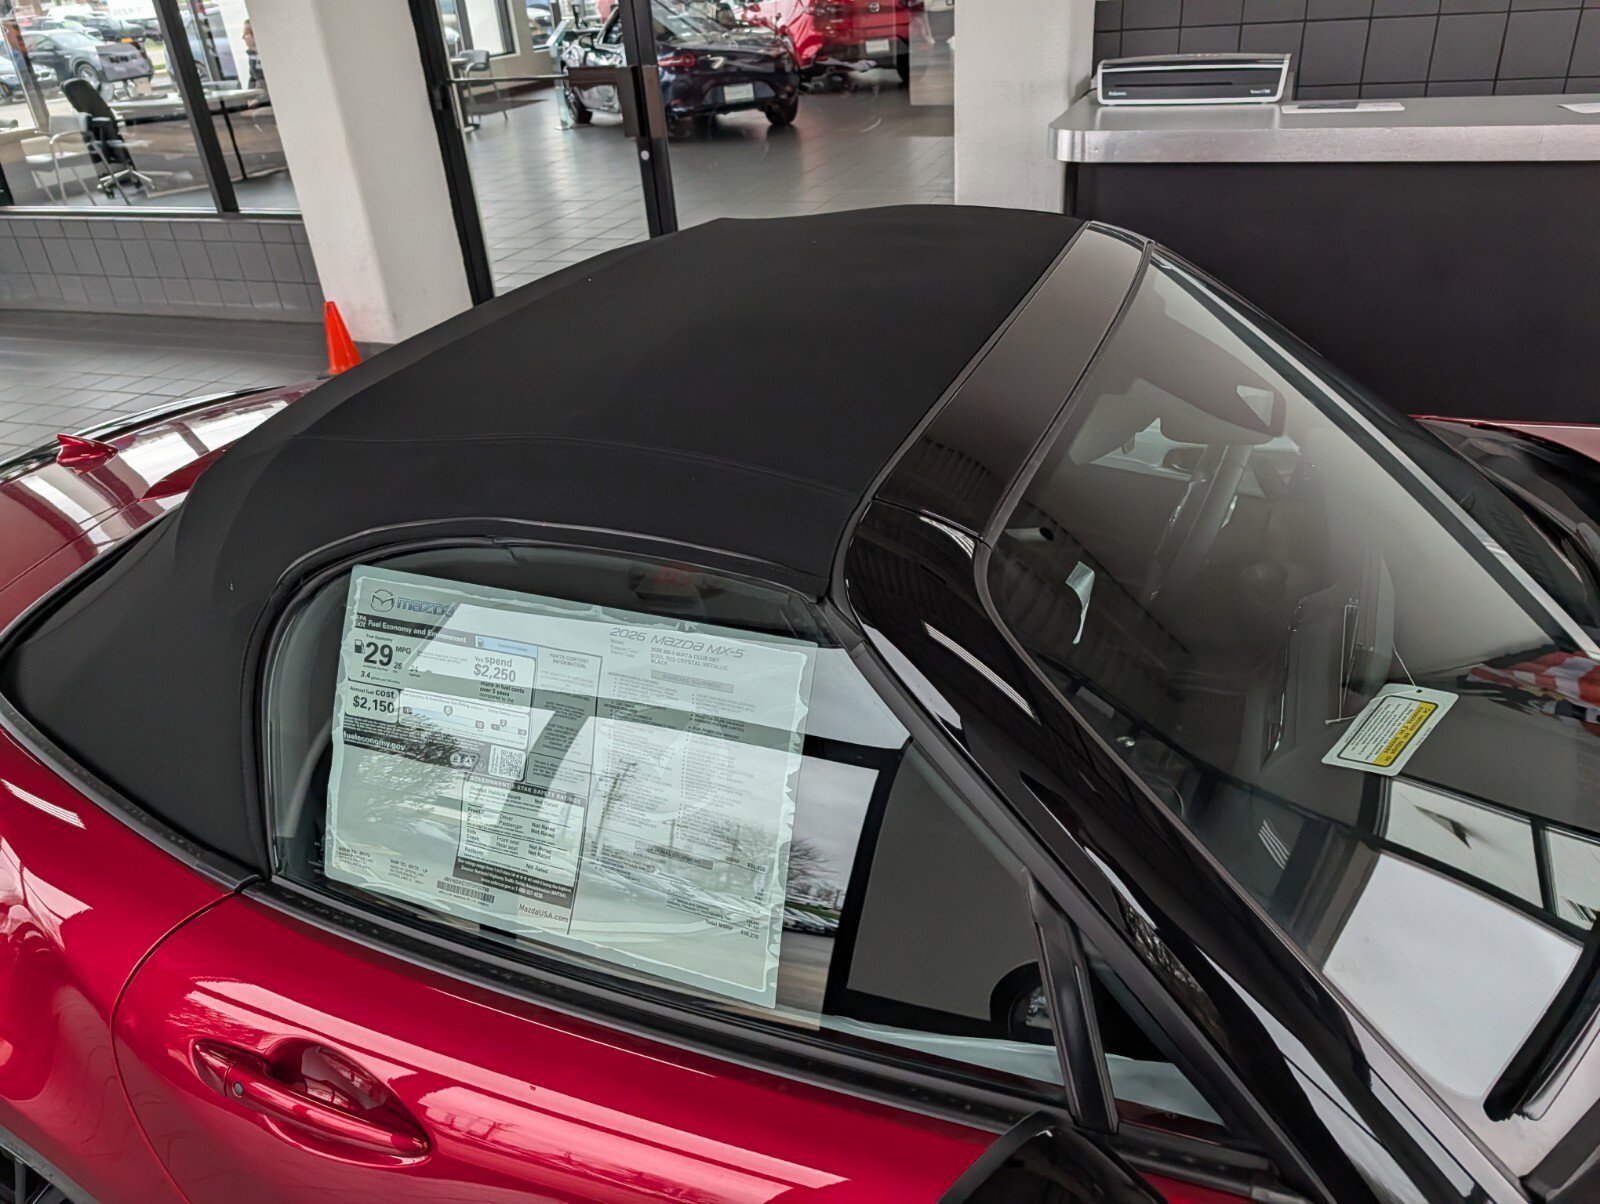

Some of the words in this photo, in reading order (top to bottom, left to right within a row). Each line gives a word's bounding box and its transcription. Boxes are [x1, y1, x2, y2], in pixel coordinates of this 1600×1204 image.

[368, 619, 381, 627] Fuel
[382, 622, 412, 634] Economy
[609, 626, 646, 642] 2026
[706, 643, 745, 658] MX-5
[363, 640, 393, 667] 29
[395, 645, 411, 654] MPG
[393, 661, 402, 669] 26
[484, 654, 512, 669] spend
[360, 670, 370, 678] 3.4
[473, 662, 516, 684] $2,250
[349, 685, 365, 693] Annual
[375, 688, 394, 698] cost
[352, 694, 395, 716] $2,150
[343, 730, 406, 752] fueleconomy.gov
[470, 773, 508, 789] GOVERNMENT
[533, 788, 554, 798] SAFETY
[506, 792, 521, 801] Score
[499, 813, 513, 821] Driver
[498, 819, 522, 830] Passenger
[647, 845, 672, 857] TIONAL
[534, 865, 548, 873] Rated
[518, 903, 568, 925] MazdaUSA.com
